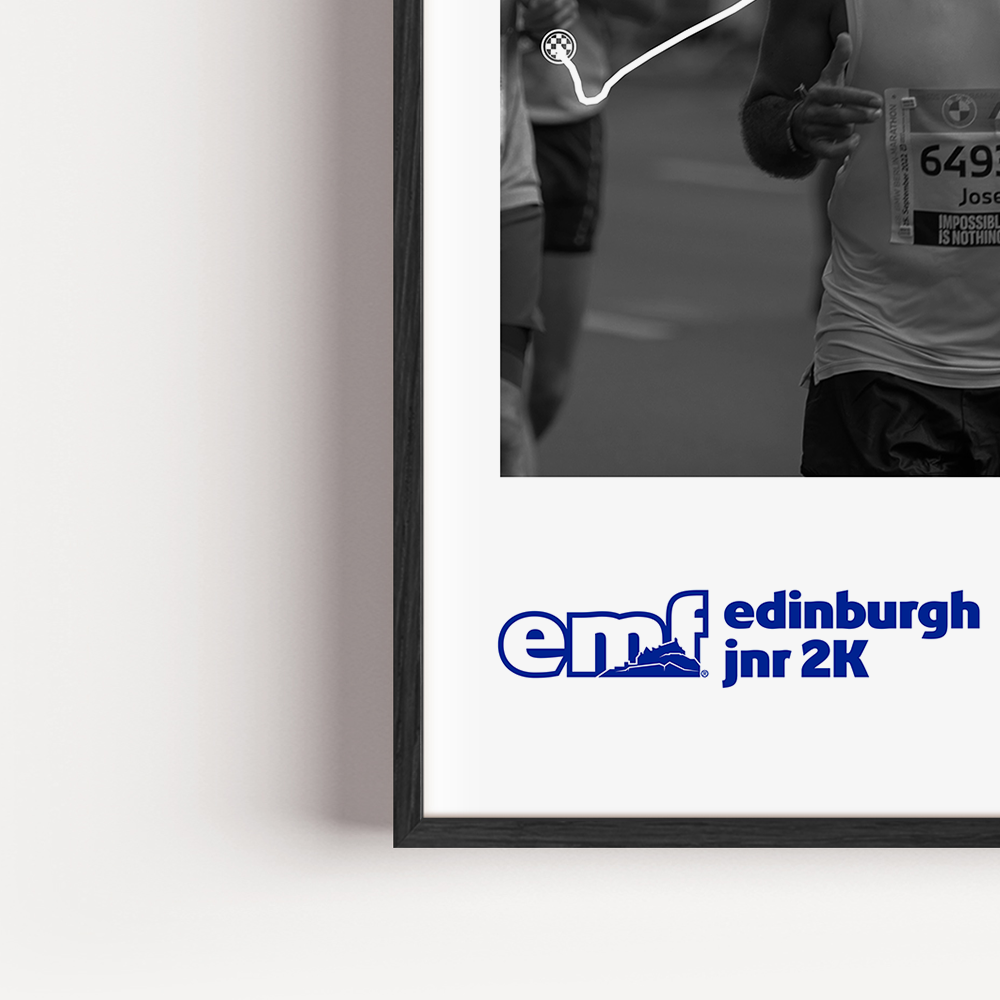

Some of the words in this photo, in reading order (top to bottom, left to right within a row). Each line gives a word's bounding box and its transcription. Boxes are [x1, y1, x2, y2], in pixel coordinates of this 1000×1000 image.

[938, 229, 951, 245] IS
[497, 589, 709, 679] emf
[723, 589, 981, 639] edinburgh
[721, 638, 793, 689] jnr
[800, 638, 870, 678] 2K
